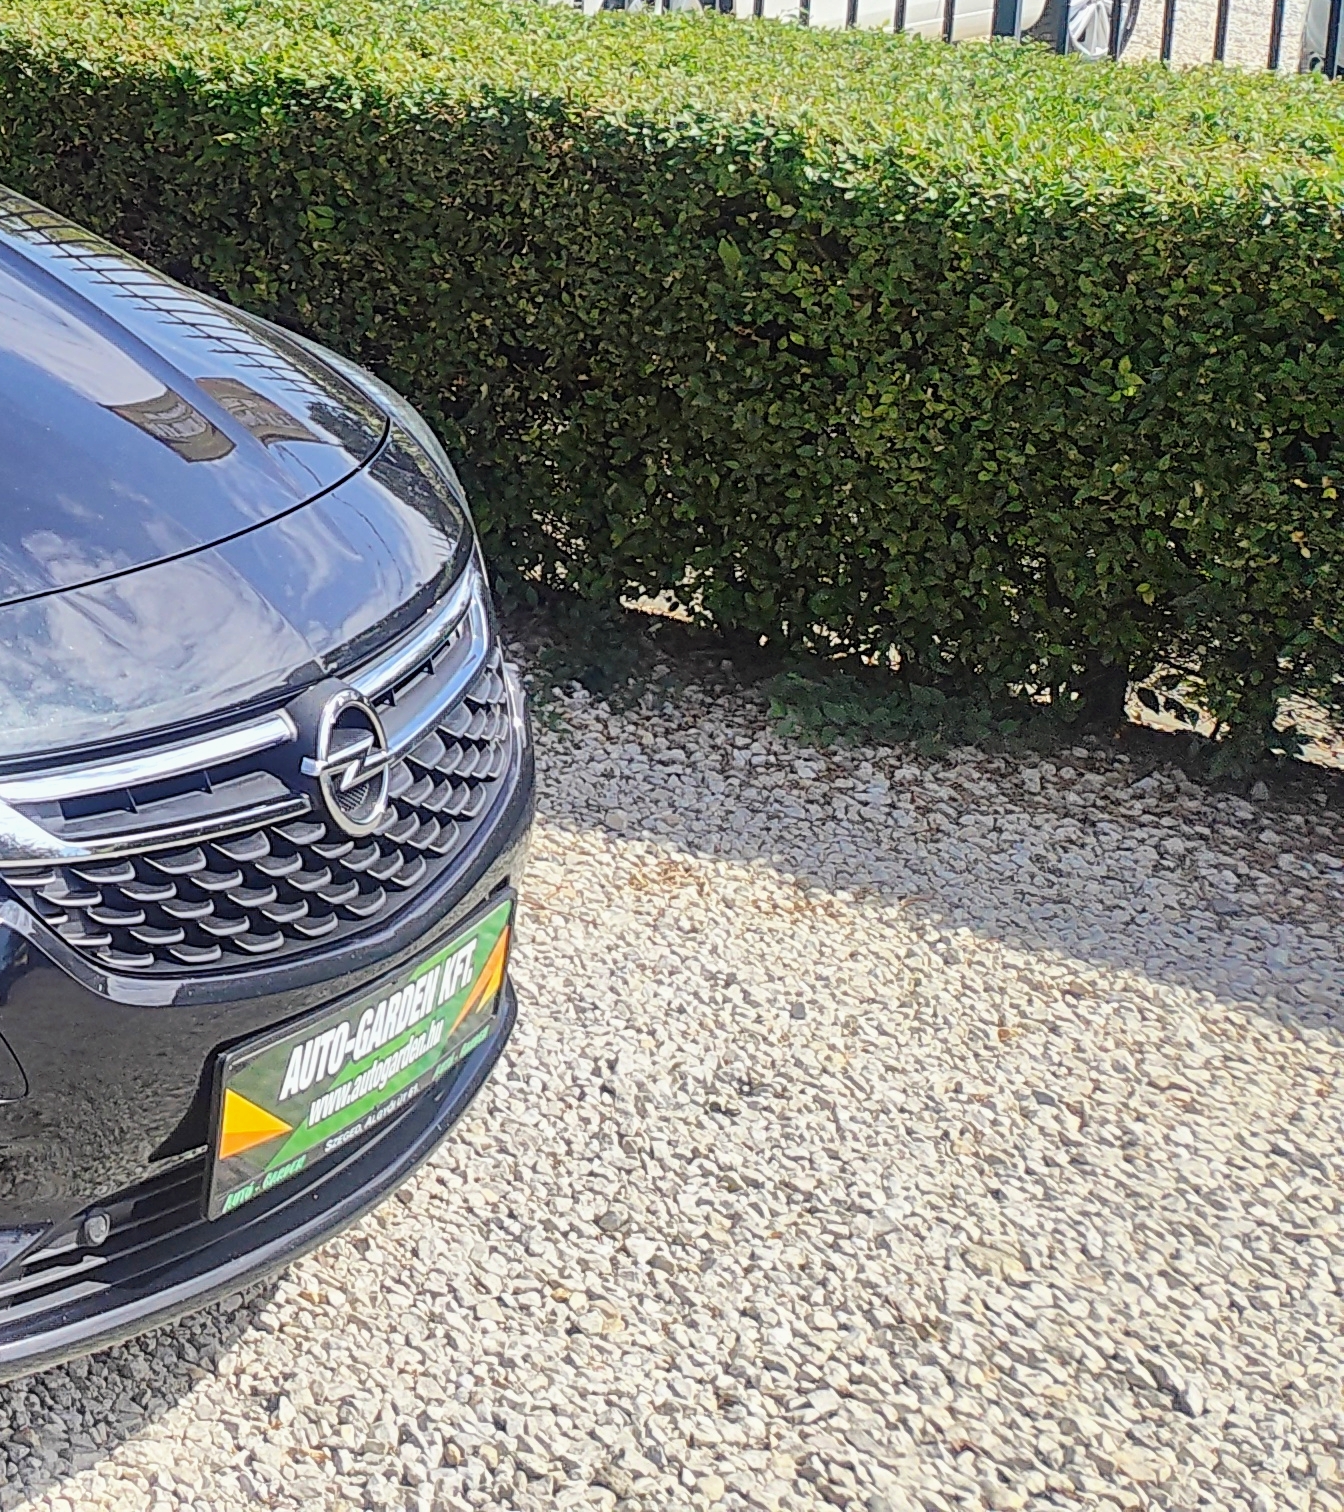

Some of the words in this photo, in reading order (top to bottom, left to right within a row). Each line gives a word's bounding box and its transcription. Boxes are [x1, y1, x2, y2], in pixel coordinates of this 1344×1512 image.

[279, 964, 441, 1101] AUTO-GARDEN
[437, 938, 478, 1005] KFT.
[308, 1019, 444, 1127] www.autogarden.hu
